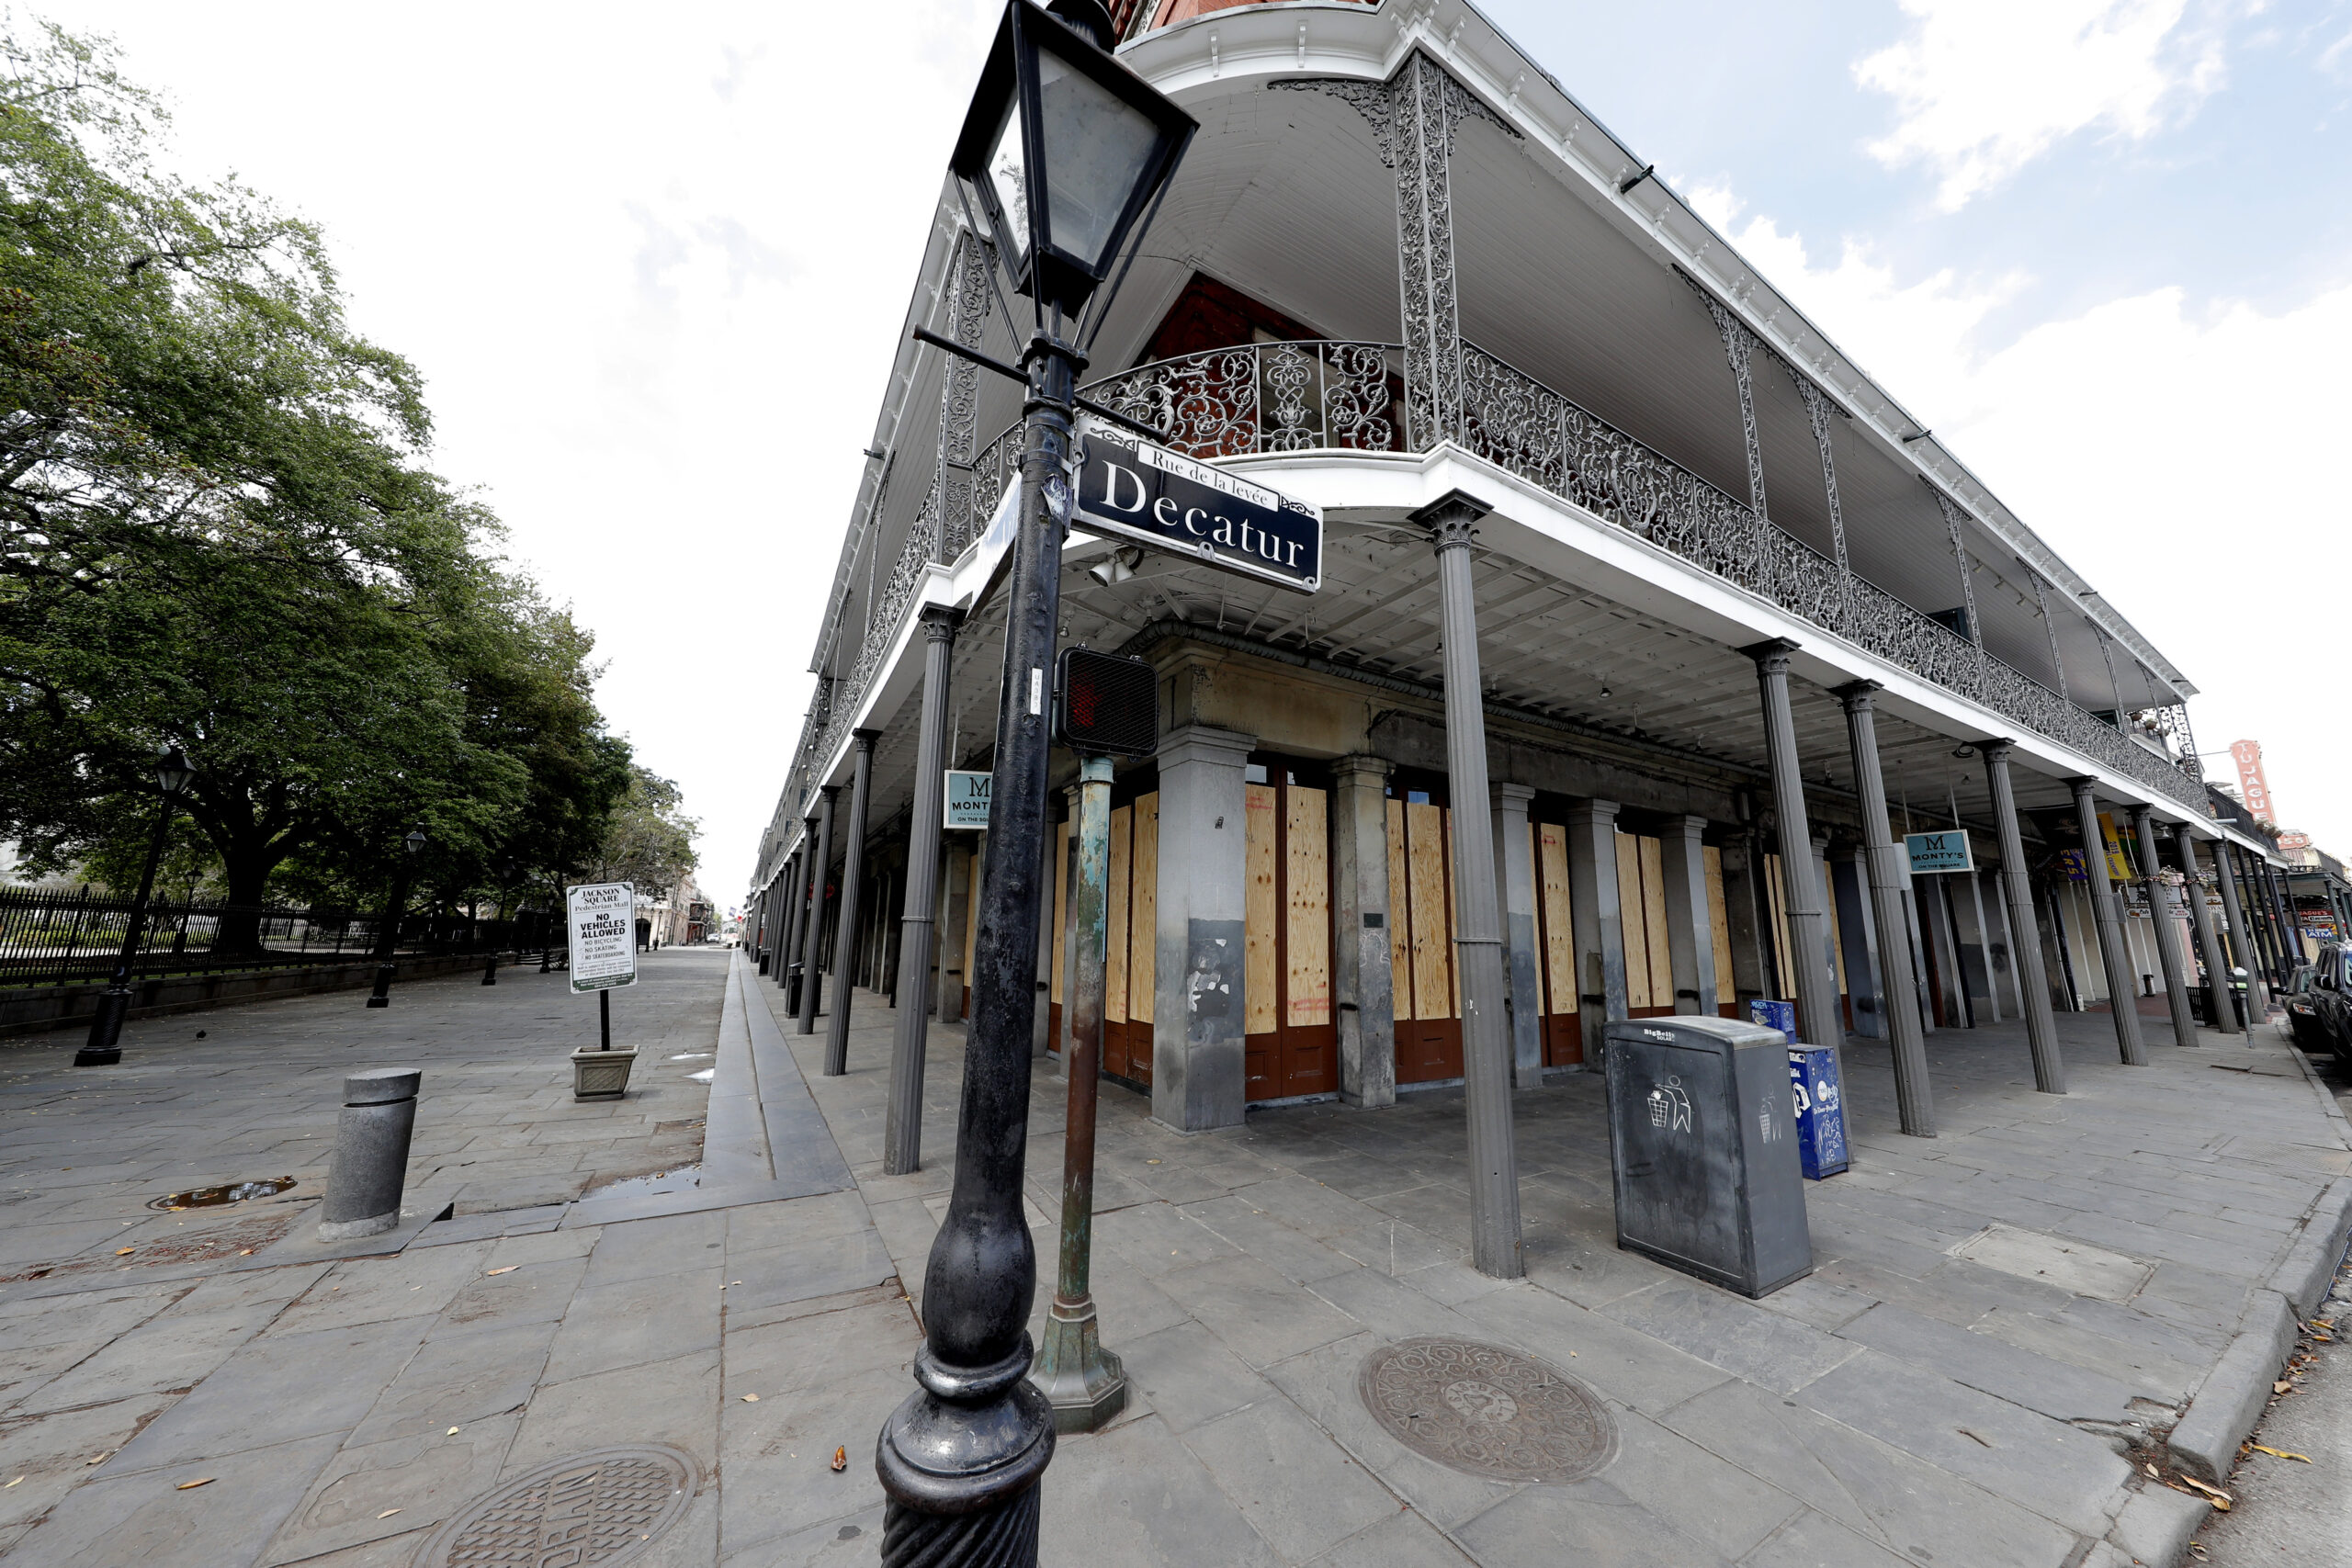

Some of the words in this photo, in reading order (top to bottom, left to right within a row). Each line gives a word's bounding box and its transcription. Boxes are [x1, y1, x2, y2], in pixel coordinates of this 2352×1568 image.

[1153, 450, 1183, 474] Rue
[1190, 466, 1208, 484] de
[1214, 473, 1227, 491] la
[1232, 479, 1268, 505] levée
[1099, 459, 1305, 568] Decatur
[969, 776, 990, 797] M
[2237, 742, 2269, 827] TUJAGUE
[952, 801, 989, 811] MONT
[1924, 835, 1946, 851] M
[1912, 852, 1963, 862] MONTY'S
[581, 887, 620, 898] JACKSON
[584, 895, 619, 905] SQUARE
[596, 913, 610, 921] NO
[581, 919, 626, 931] VEHICLES
[582, 928, 626, 939] ALLOWED
